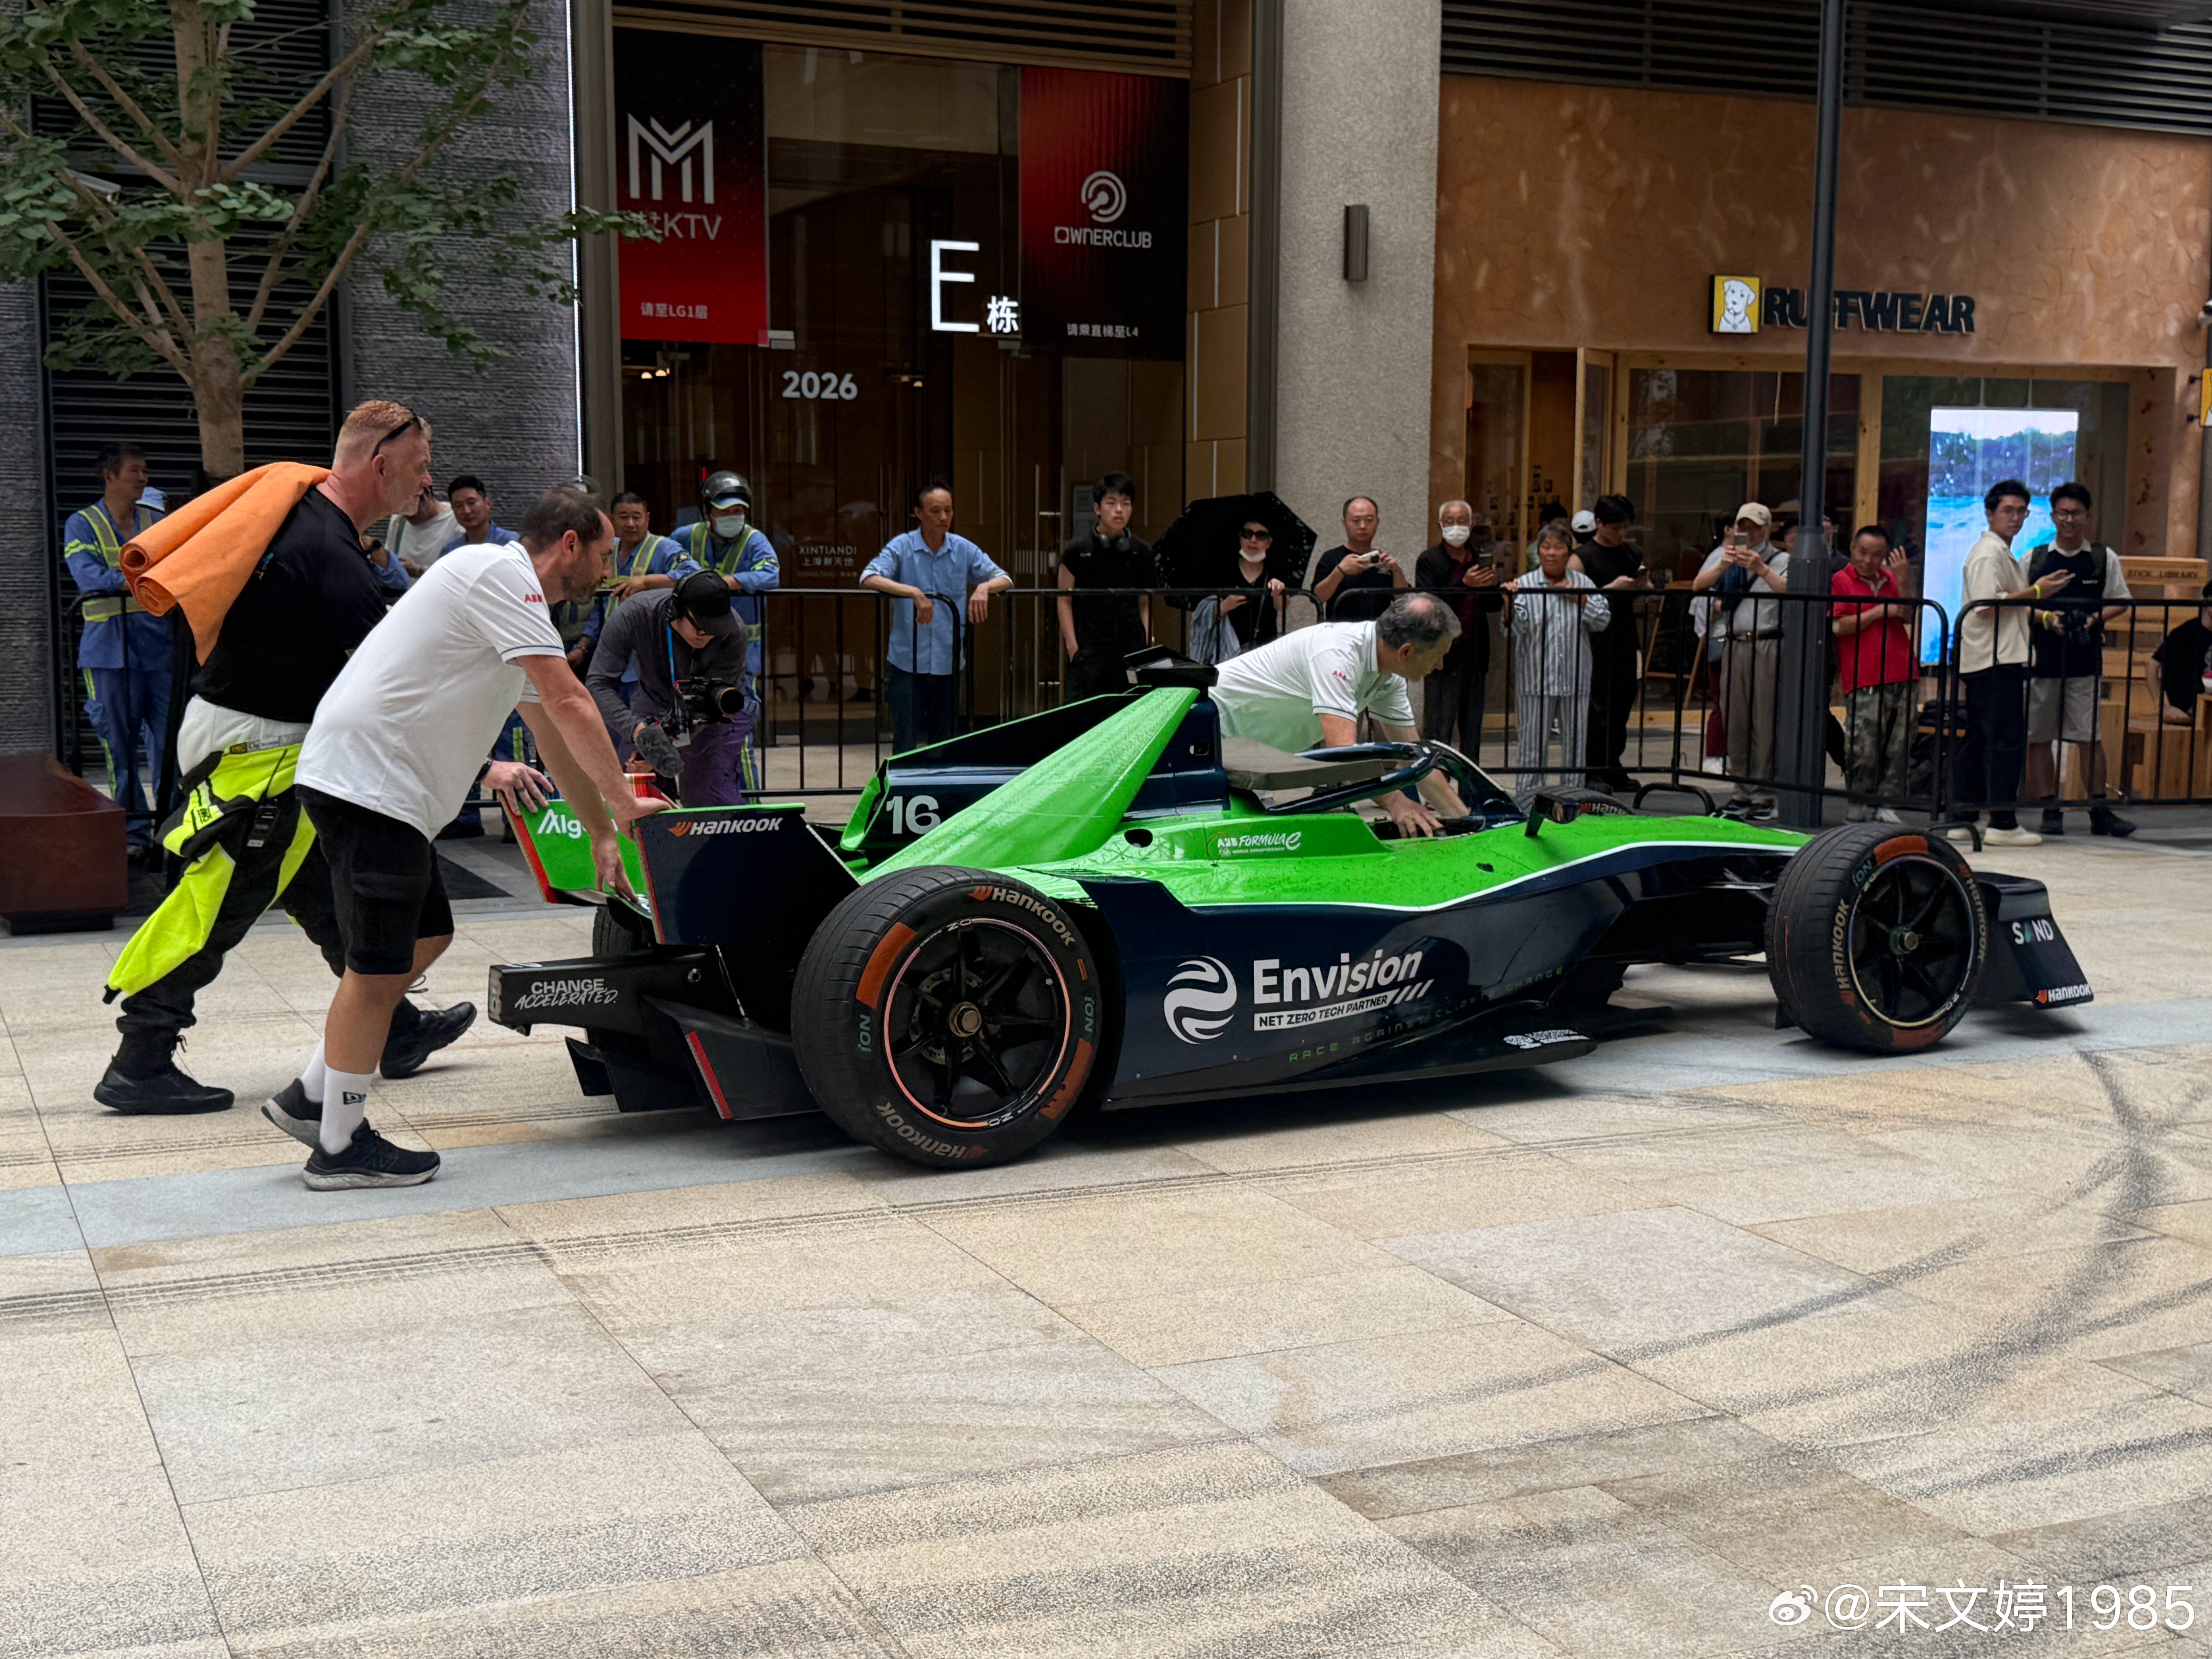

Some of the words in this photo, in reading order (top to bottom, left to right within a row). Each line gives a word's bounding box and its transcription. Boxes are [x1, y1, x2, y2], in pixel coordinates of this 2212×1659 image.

[1762, 287, 1975, 333] RUFWEAR
[781, 370, 858, 401] 2026
[799, 545, 857, 555] XINTIANDI
[2159, 570, 2199, 579] LIBRARY
[525, 594, 543, 603] ABB
[886, 795, 941, 835] 16
[1218, 837, 1238, 848] ABB
[1239, 833, 1286, 848] FORMULA
[1253, 949, 1423, 1004] Envision
[1259, 1015, 1285, 1027] NET
[1287, 1011, 1317, 1025] ZERO
[1319, 1006, 1344, 1020] TECH
[1346, 994, 1389, 1015] PARTNER
[1288, 1041, 1339, 1063] RACE
